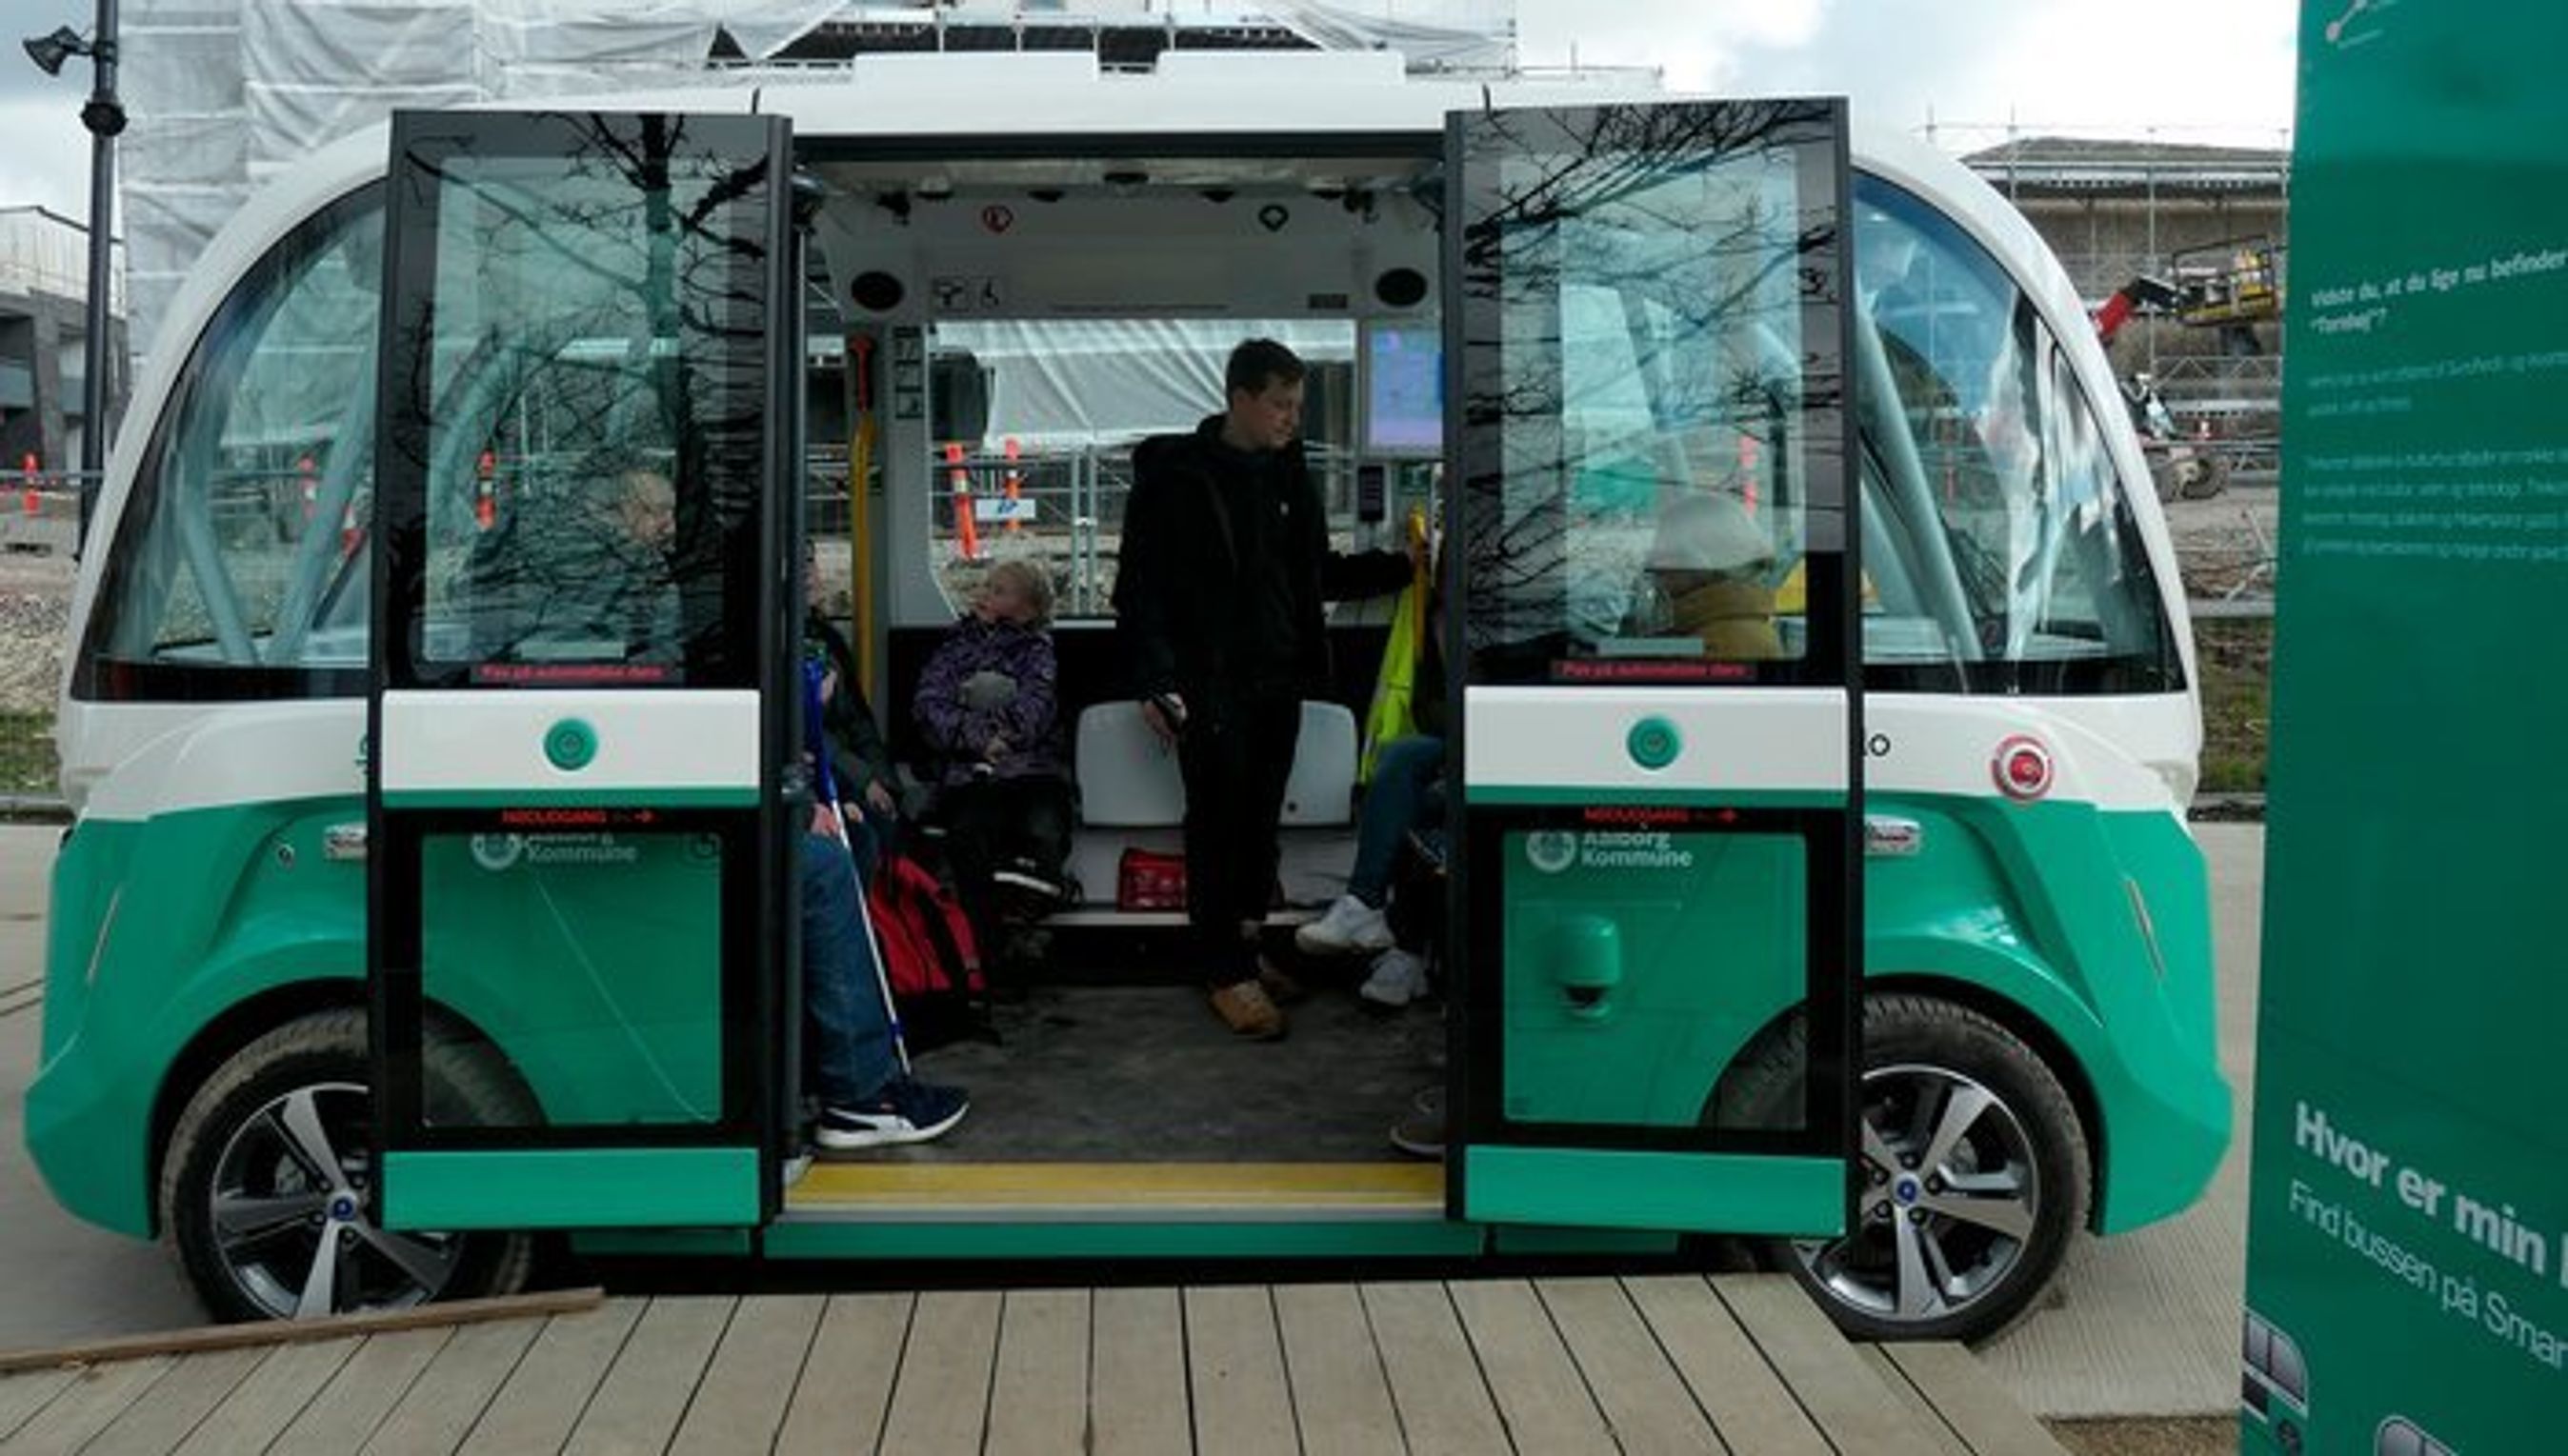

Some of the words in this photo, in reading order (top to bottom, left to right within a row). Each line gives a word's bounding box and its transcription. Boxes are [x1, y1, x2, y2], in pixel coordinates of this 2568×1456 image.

[2385, 277, 2401, 296] at
[2406, 271, 2426, 292] du
[2465, 265, 2486, 283] nu
[2490, 249, 2567, 279] befinder
[528, 843, 637, 864] Kommune
[1581, 848, 1693, 868] Kommune
[2295, 1100, 2389, 1187] Hvor
[2397, 1167, 2446, 1216] er
[2454, 1195, 2547, 1275] min
[2289, 1178, 2342, 1237] Find
[2343, 1210, 2438, 1293] bussen
[2441, 1274, 2478, 1321] på
